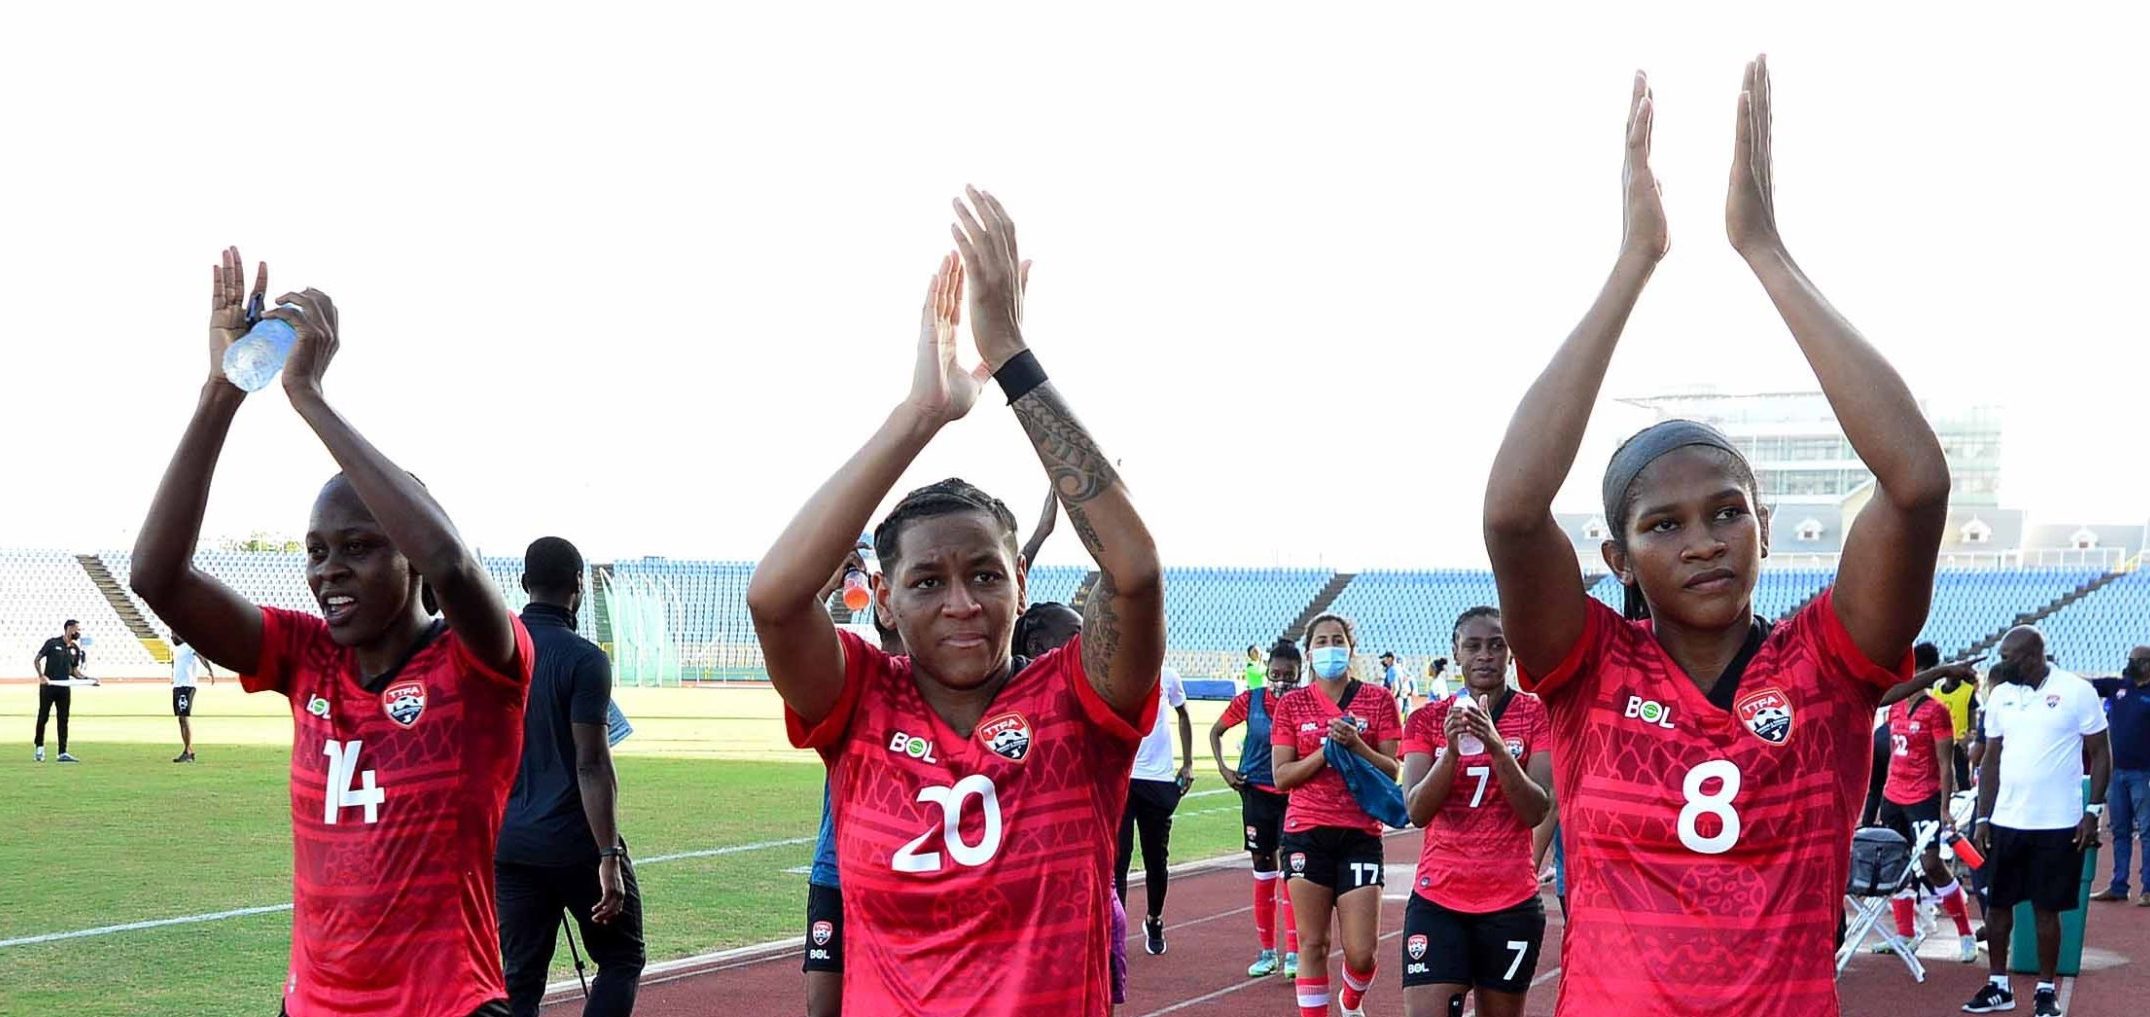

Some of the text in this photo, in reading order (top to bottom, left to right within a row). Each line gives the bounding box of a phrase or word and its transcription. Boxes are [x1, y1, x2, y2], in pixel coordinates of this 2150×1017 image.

[1625, 695, 1675, 729] BOL
[1742, 695, 1779, 713] TTFA
[982, 718, 1019, 736] TTFA
[889, 731, 938, 764] BOL
[323, 739, 386, 825] 14
[1466, 766, 1490, 808] 7
[1677, 759, 1741, 854] 8
[891, 774, 1003, 873] 20
[1350, 862, 1379, 887] 17
[810, 949, 830, 960] BOL
[1407, 962, 1430, 974] BOL
[1503, 940, 1528, 980] 7
